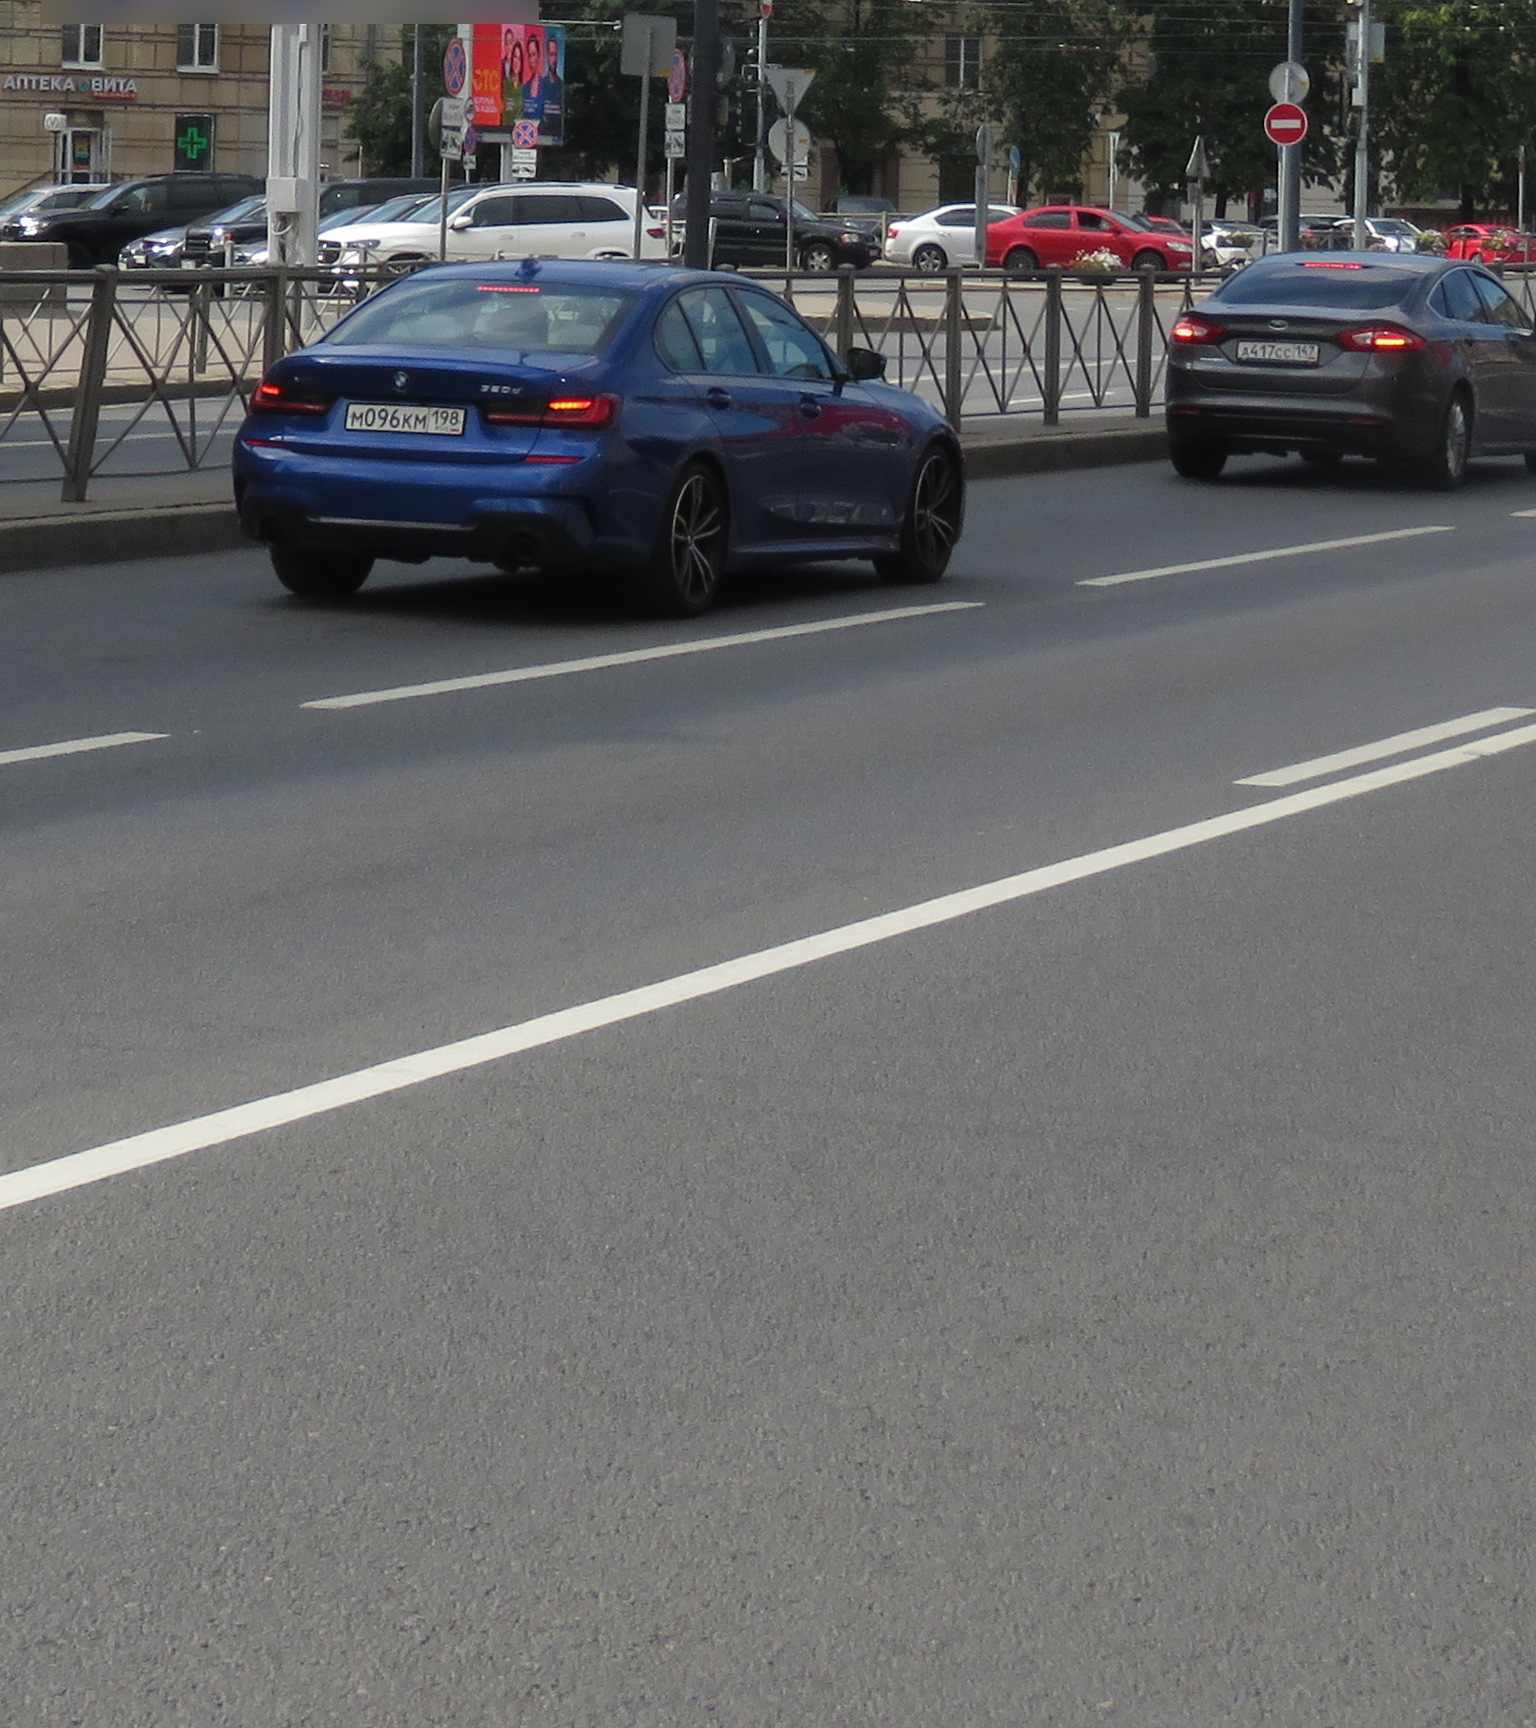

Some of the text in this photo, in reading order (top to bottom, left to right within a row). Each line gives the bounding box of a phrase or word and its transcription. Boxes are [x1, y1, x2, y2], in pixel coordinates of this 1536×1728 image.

[3, 75, 137, 93] АПТЕКА ВИТА
[432, 410, 459, 425] 198
